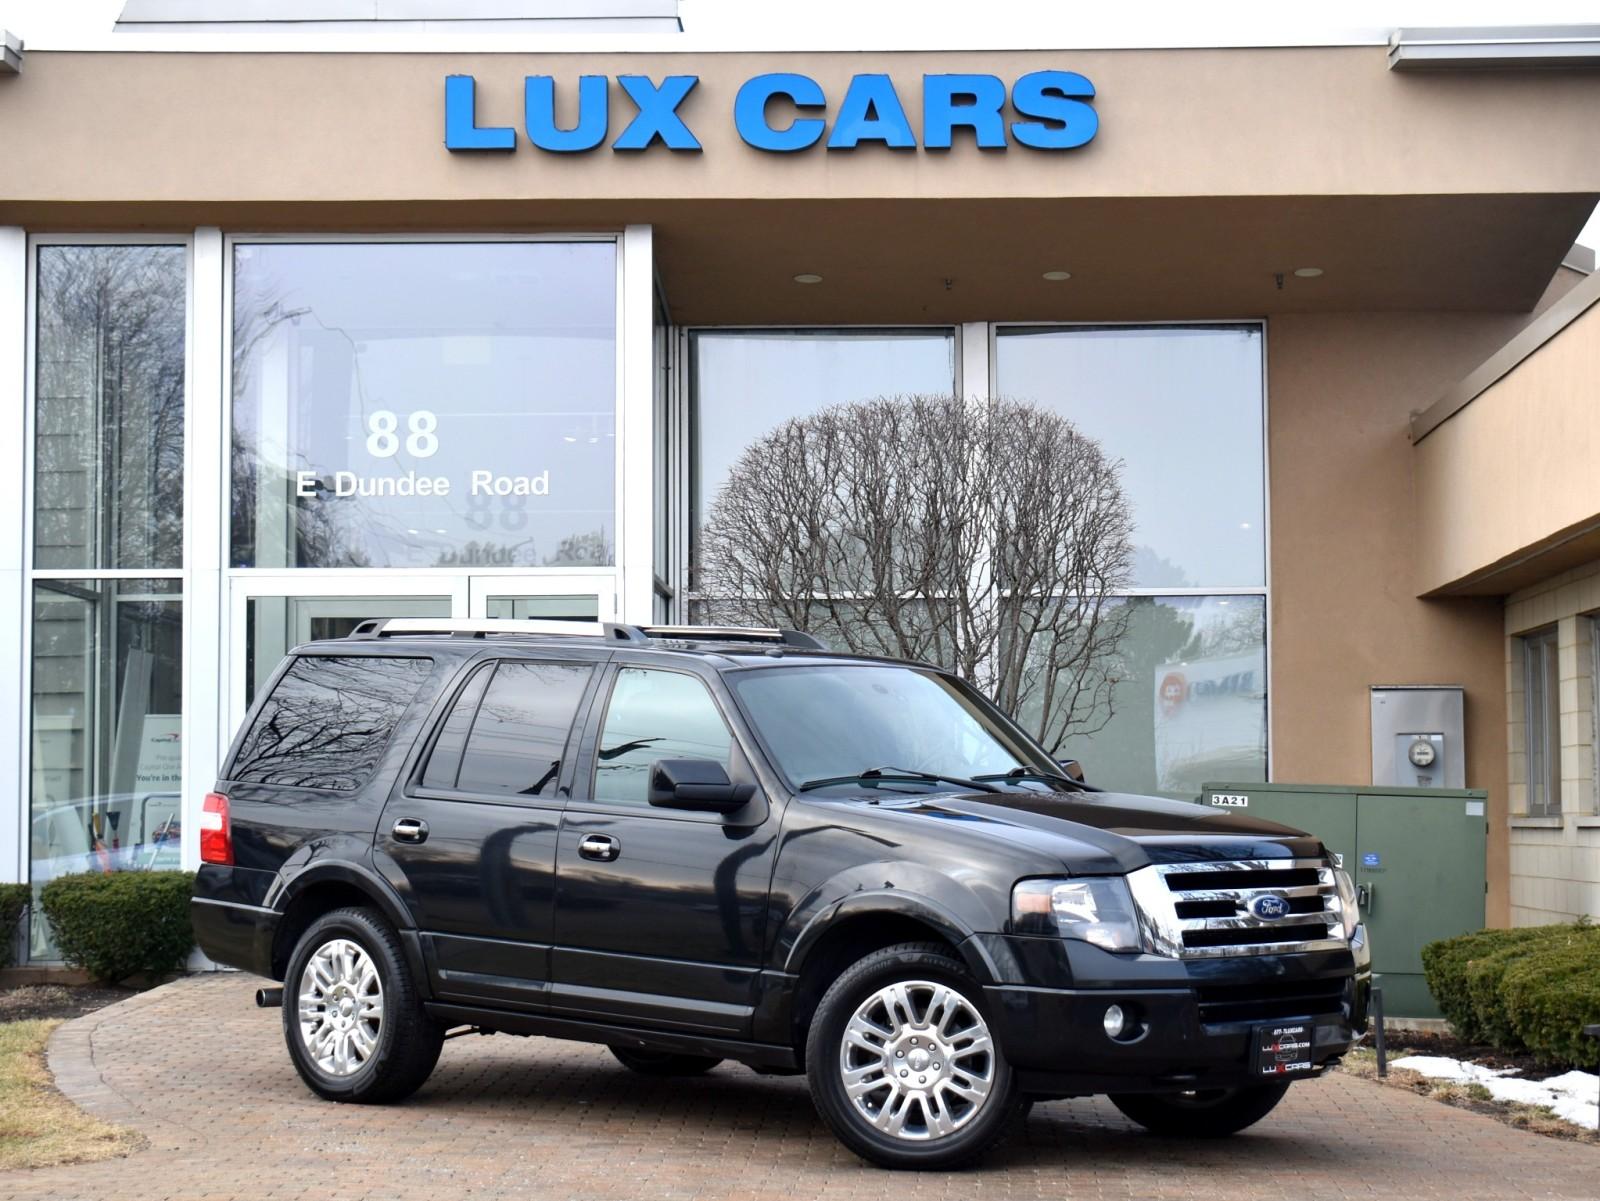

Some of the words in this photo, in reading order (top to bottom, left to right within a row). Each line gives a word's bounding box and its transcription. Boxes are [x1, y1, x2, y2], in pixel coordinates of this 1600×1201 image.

[445, 74, 703, 153] LUX
[733, 70, 1099, 153] CARS
[366, 409, 440, 458] 88
[296, 470, 317, 497] E
[335, 470, 451, 497] Dundee
[471, 470, 550, 496] Road
[136, 773, 161, 782] You're
[161, 773, 170, 782] in
[1213, 796, 1246, 806] 3A21
[1261, 899, 1284, 914] Ford
